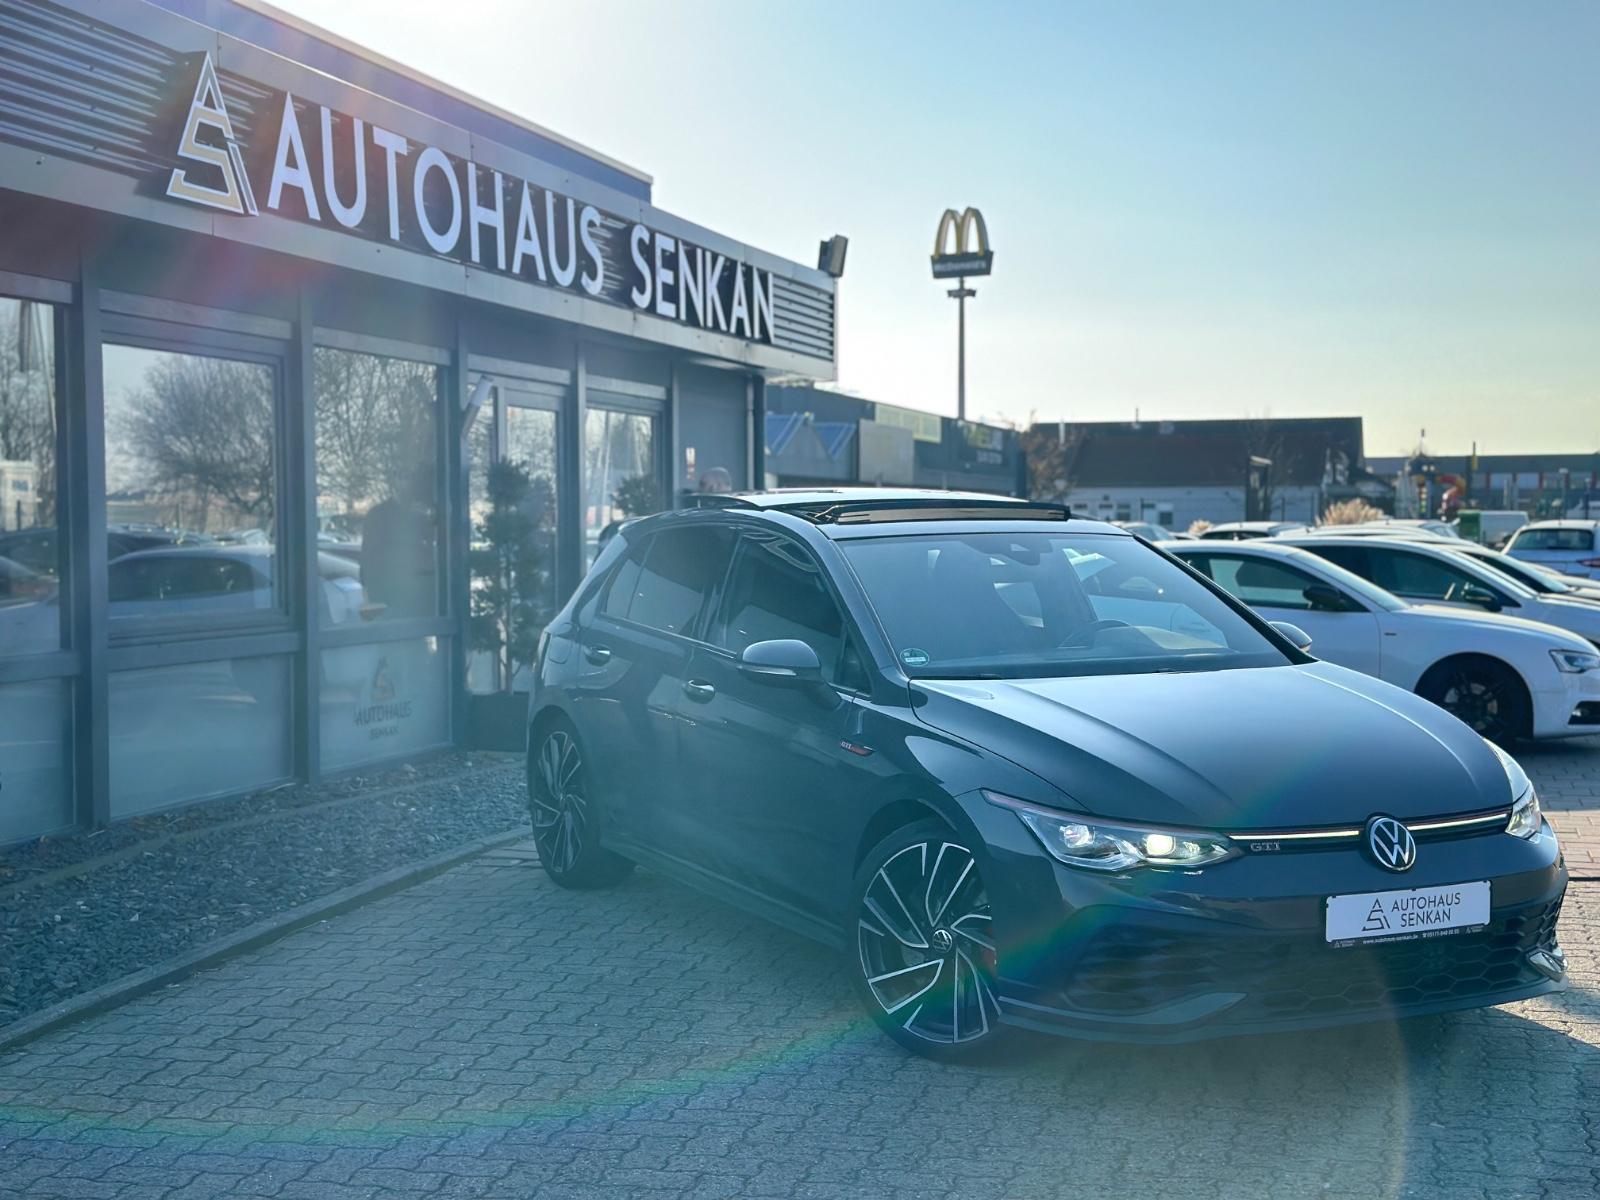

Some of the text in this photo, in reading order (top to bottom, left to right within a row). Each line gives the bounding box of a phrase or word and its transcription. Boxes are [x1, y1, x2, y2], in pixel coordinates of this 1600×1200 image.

[267, 91, 774, 344] AUTOHAUS SENKAN
[354, 701, 413, 727] AUTOHAUS
[1250, 842, 1281, 852] GTI
[1391, 892, 1461, 912] AUTOHAUS
[1400, 908, 1451, 928] SENKAN
